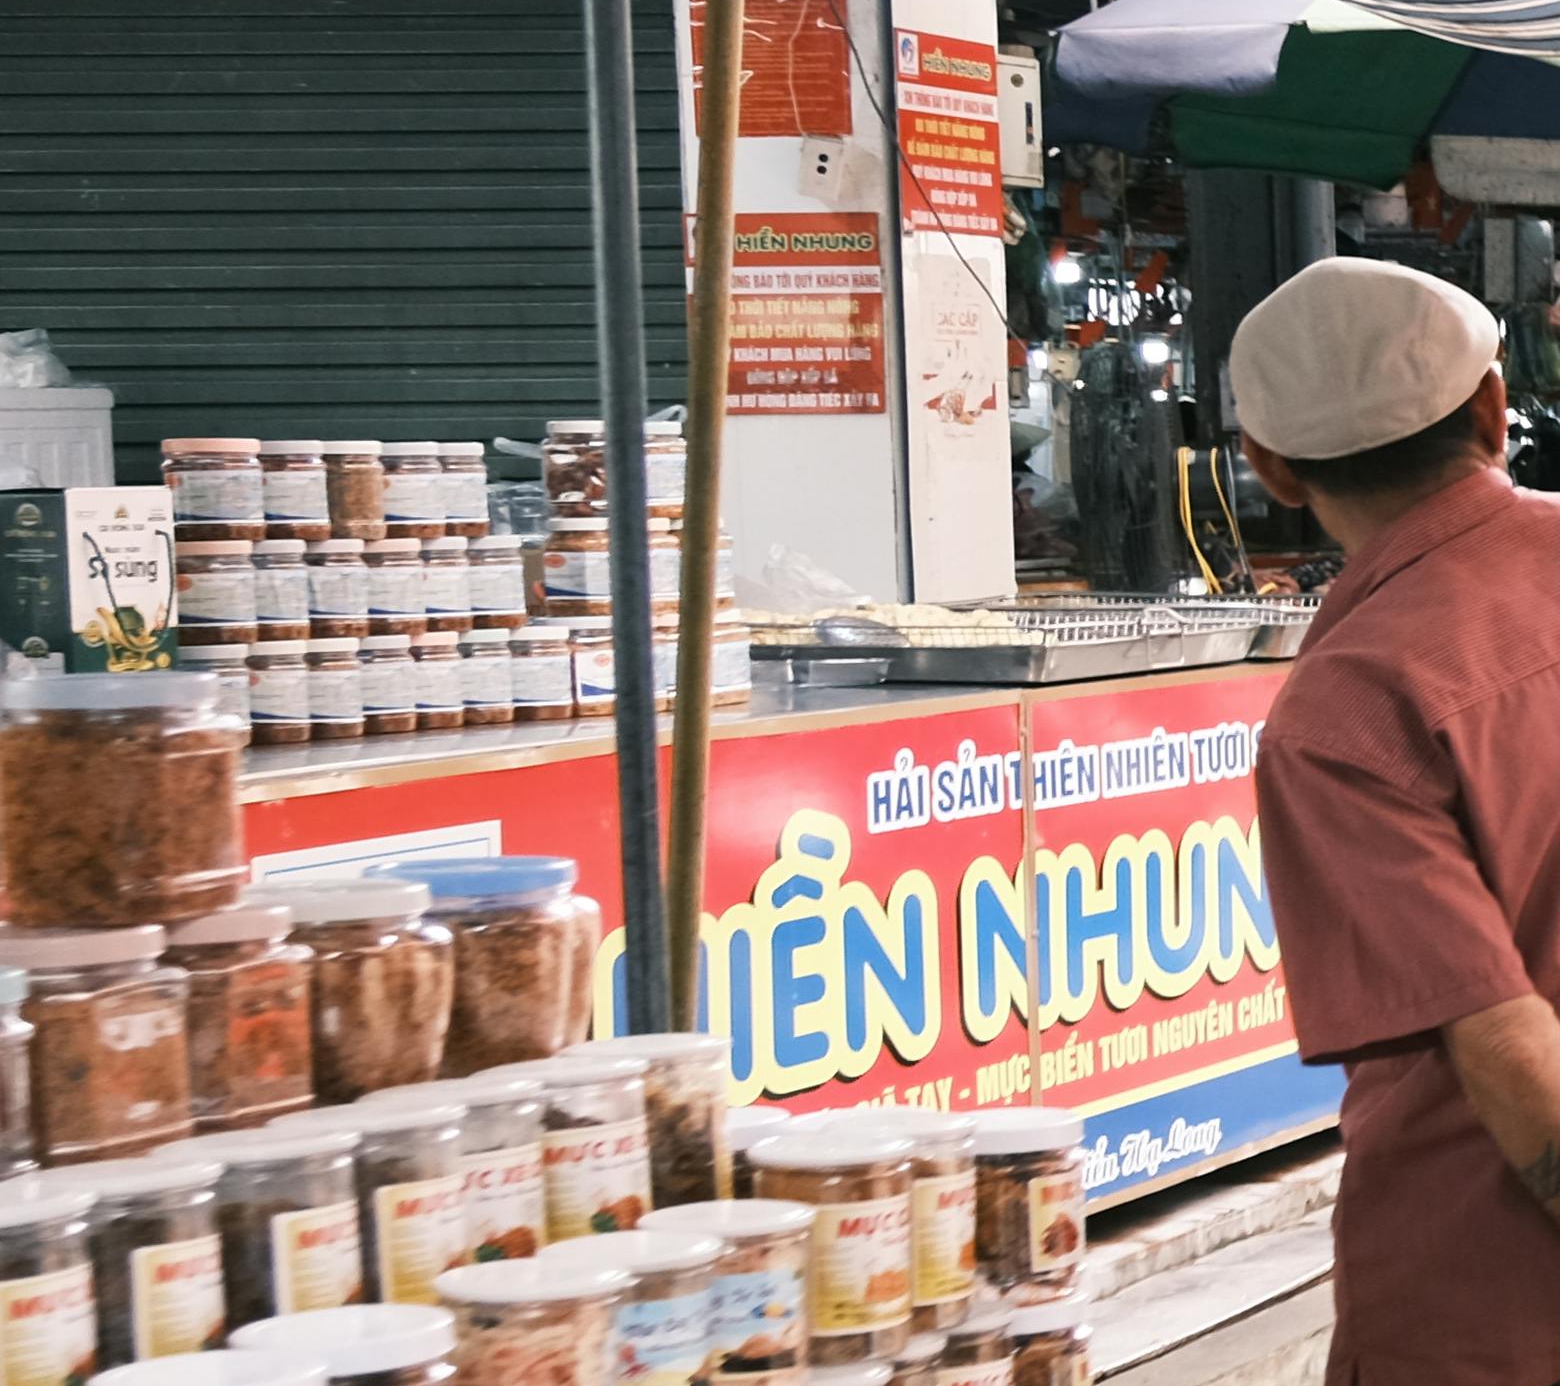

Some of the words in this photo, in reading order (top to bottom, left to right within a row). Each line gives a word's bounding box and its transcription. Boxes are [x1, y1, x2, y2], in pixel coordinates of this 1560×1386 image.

[792, 233, 874, 252] NHUNG
[871, 752, 925, 826] HẢI
[937, 746, 999, 815] SẢN
[1007, 745, 1096, 805] THIÊN
[1105, 733, 1186, 791] NHIÊN
[1193, 726, 1246, 777] TƯƠI
[970, 831, 1280, 1022] NHUN
[975, 1053, 1032, 1106] MỰC
[1099, 1022, 1149, 1073] TƯƠI
[1152, 999, 1234, 1058] NGUYÊN
[1237, 981, 1287, 1033] CHẤT
